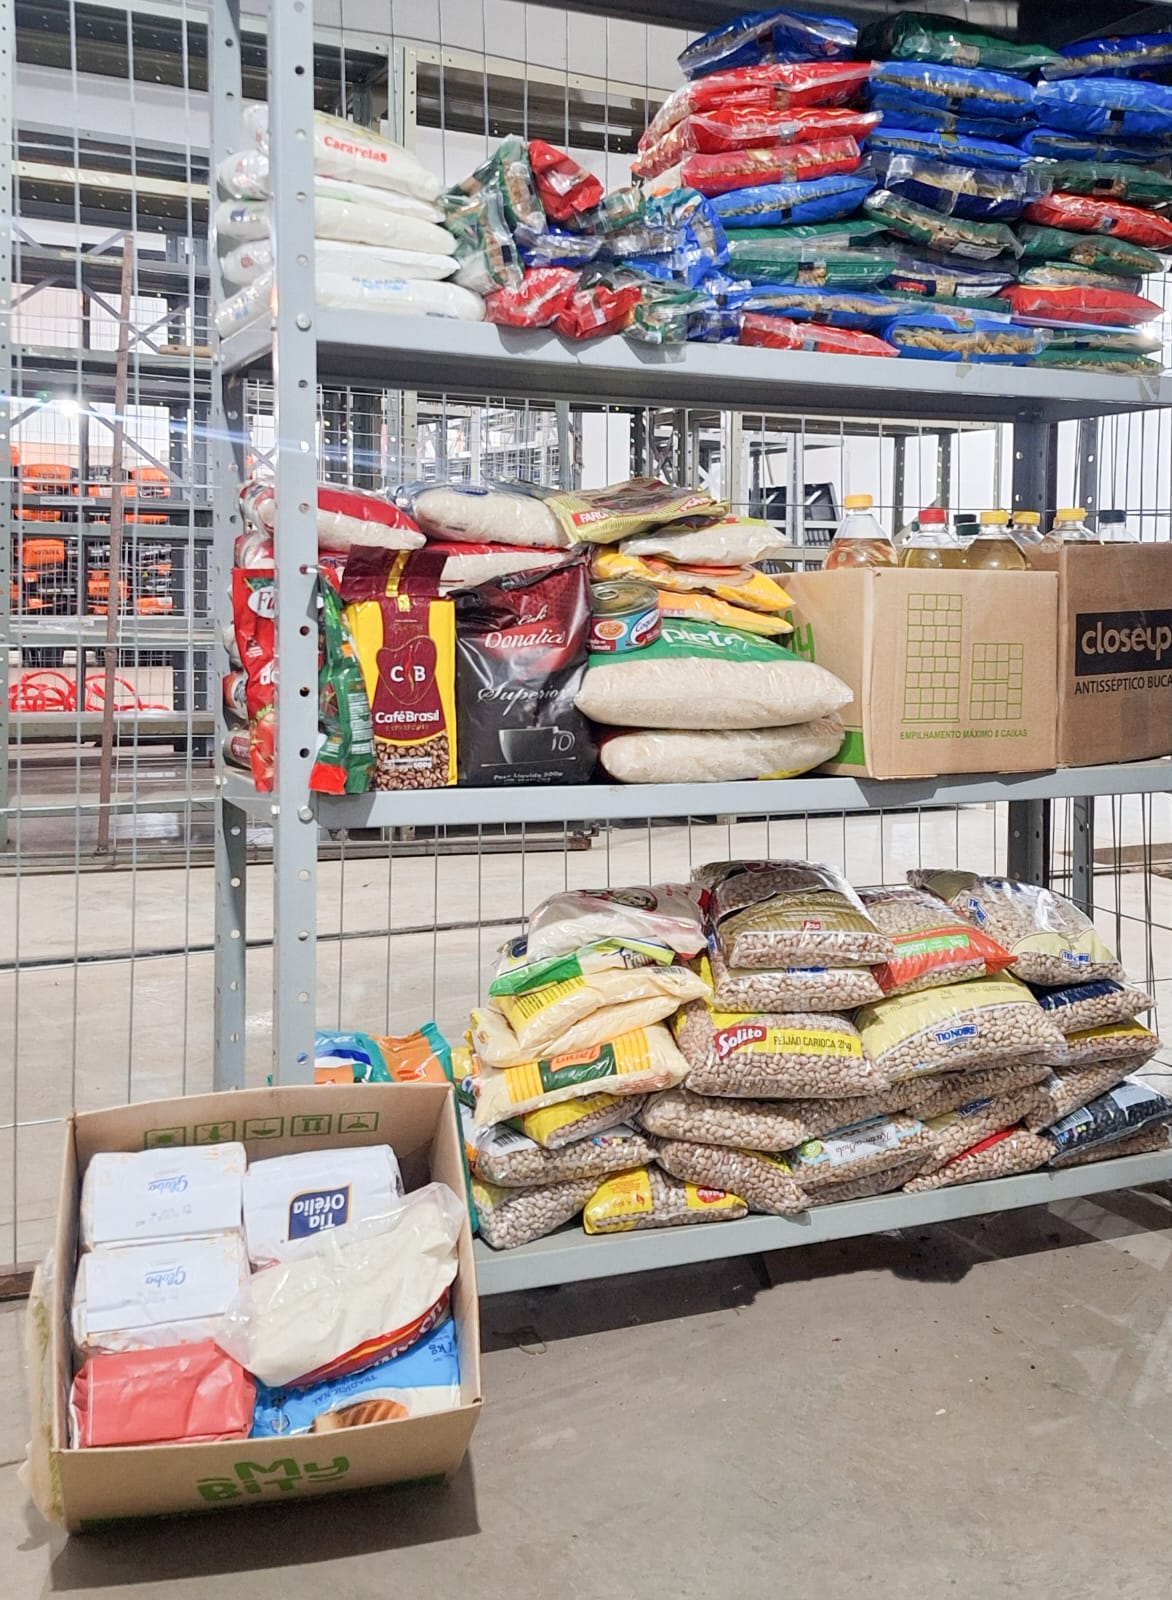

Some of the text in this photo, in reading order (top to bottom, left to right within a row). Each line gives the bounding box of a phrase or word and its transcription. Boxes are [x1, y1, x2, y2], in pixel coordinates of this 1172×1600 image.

[1081, 621, 1172, 661] closeup
[1074, 677, 1145, 695] ANTISSÉPTICO
[900, 730, 961, 740] EMPILHAMENTO
[1001, 728, 1028, 738] CAIXAS
[718, 1028, 762, 1057] Solito
[803, 1036, 836, 1049] CARIOCA
[293, 1193, 345, 1216] Ofélia
[309, 1212, 335, 1230] Tia
